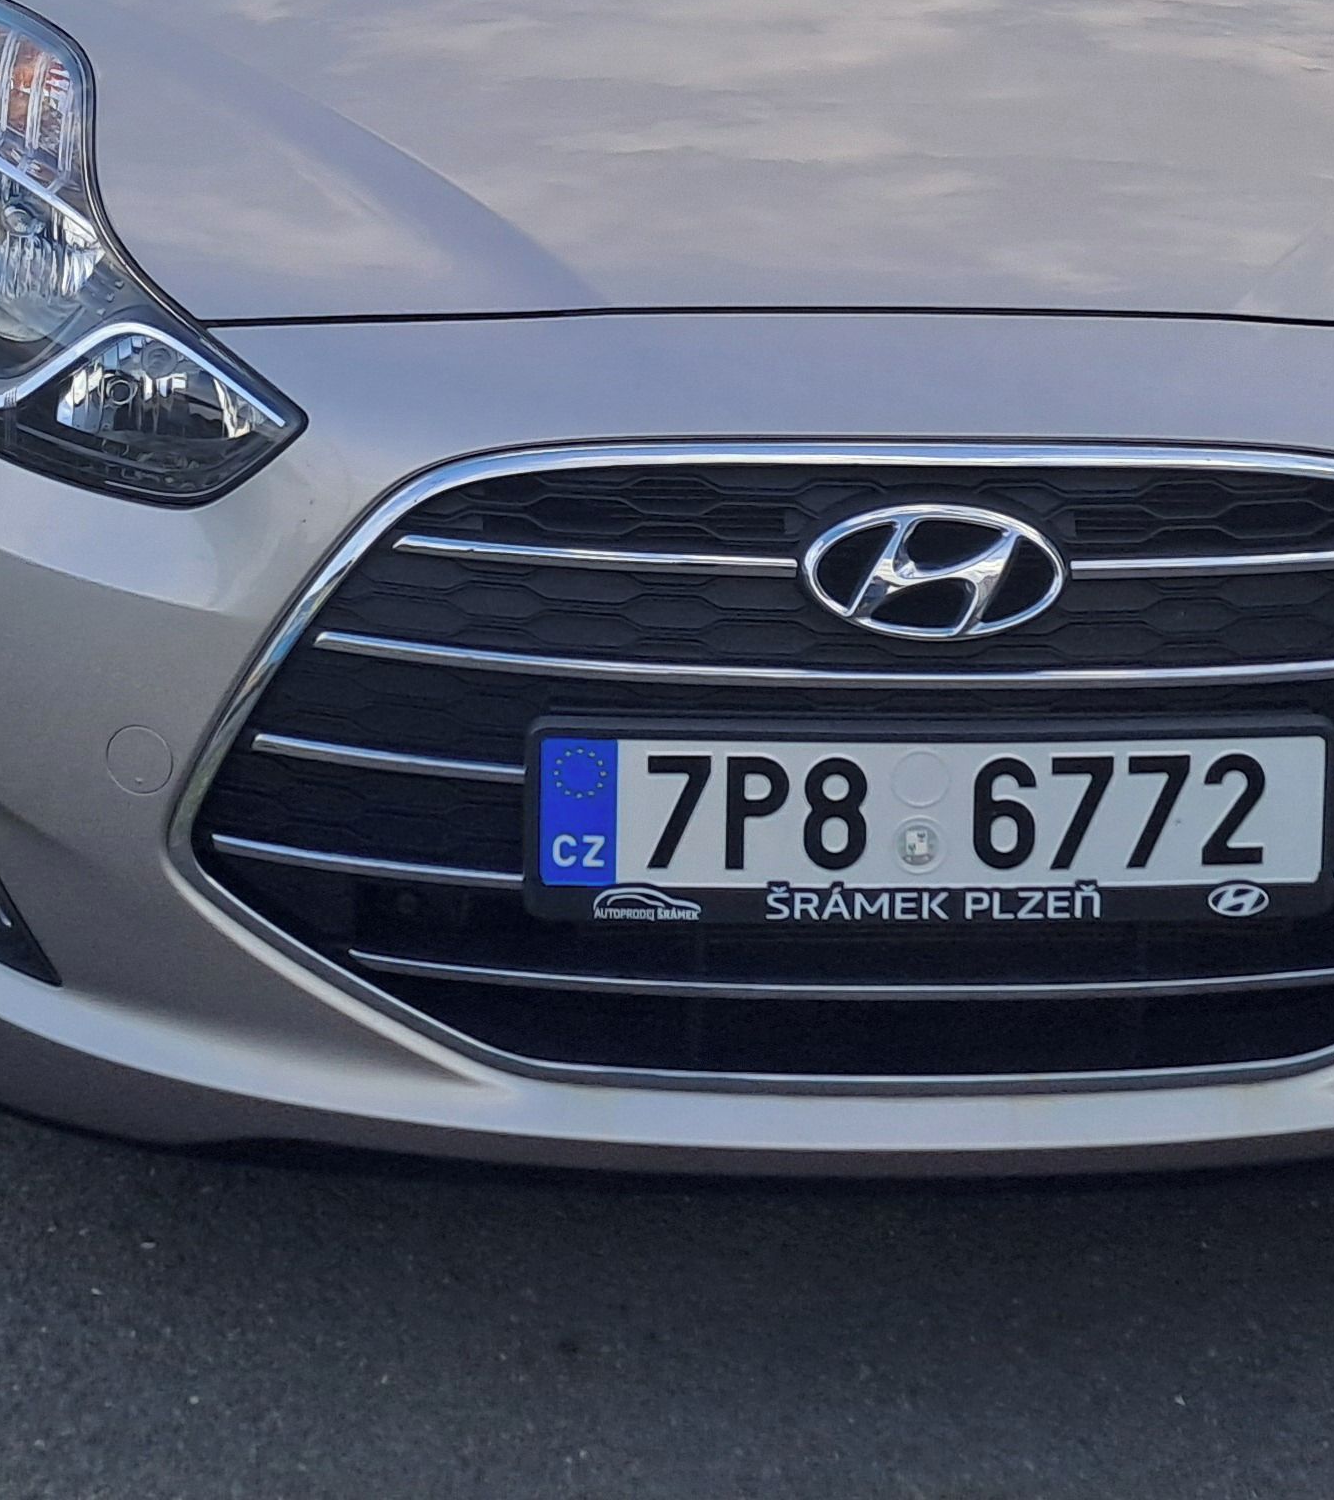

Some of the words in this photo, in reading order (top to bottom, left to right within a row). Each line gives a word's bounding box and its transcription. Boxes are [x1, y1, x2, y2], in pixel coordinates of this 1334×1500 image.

[646, 755, 868, 871] 7P8
[972, 753, 1266, 870] 6772
[552, 834, 605, 868] CZ
[765, 885, 949, 921] ŠRÁMEK
